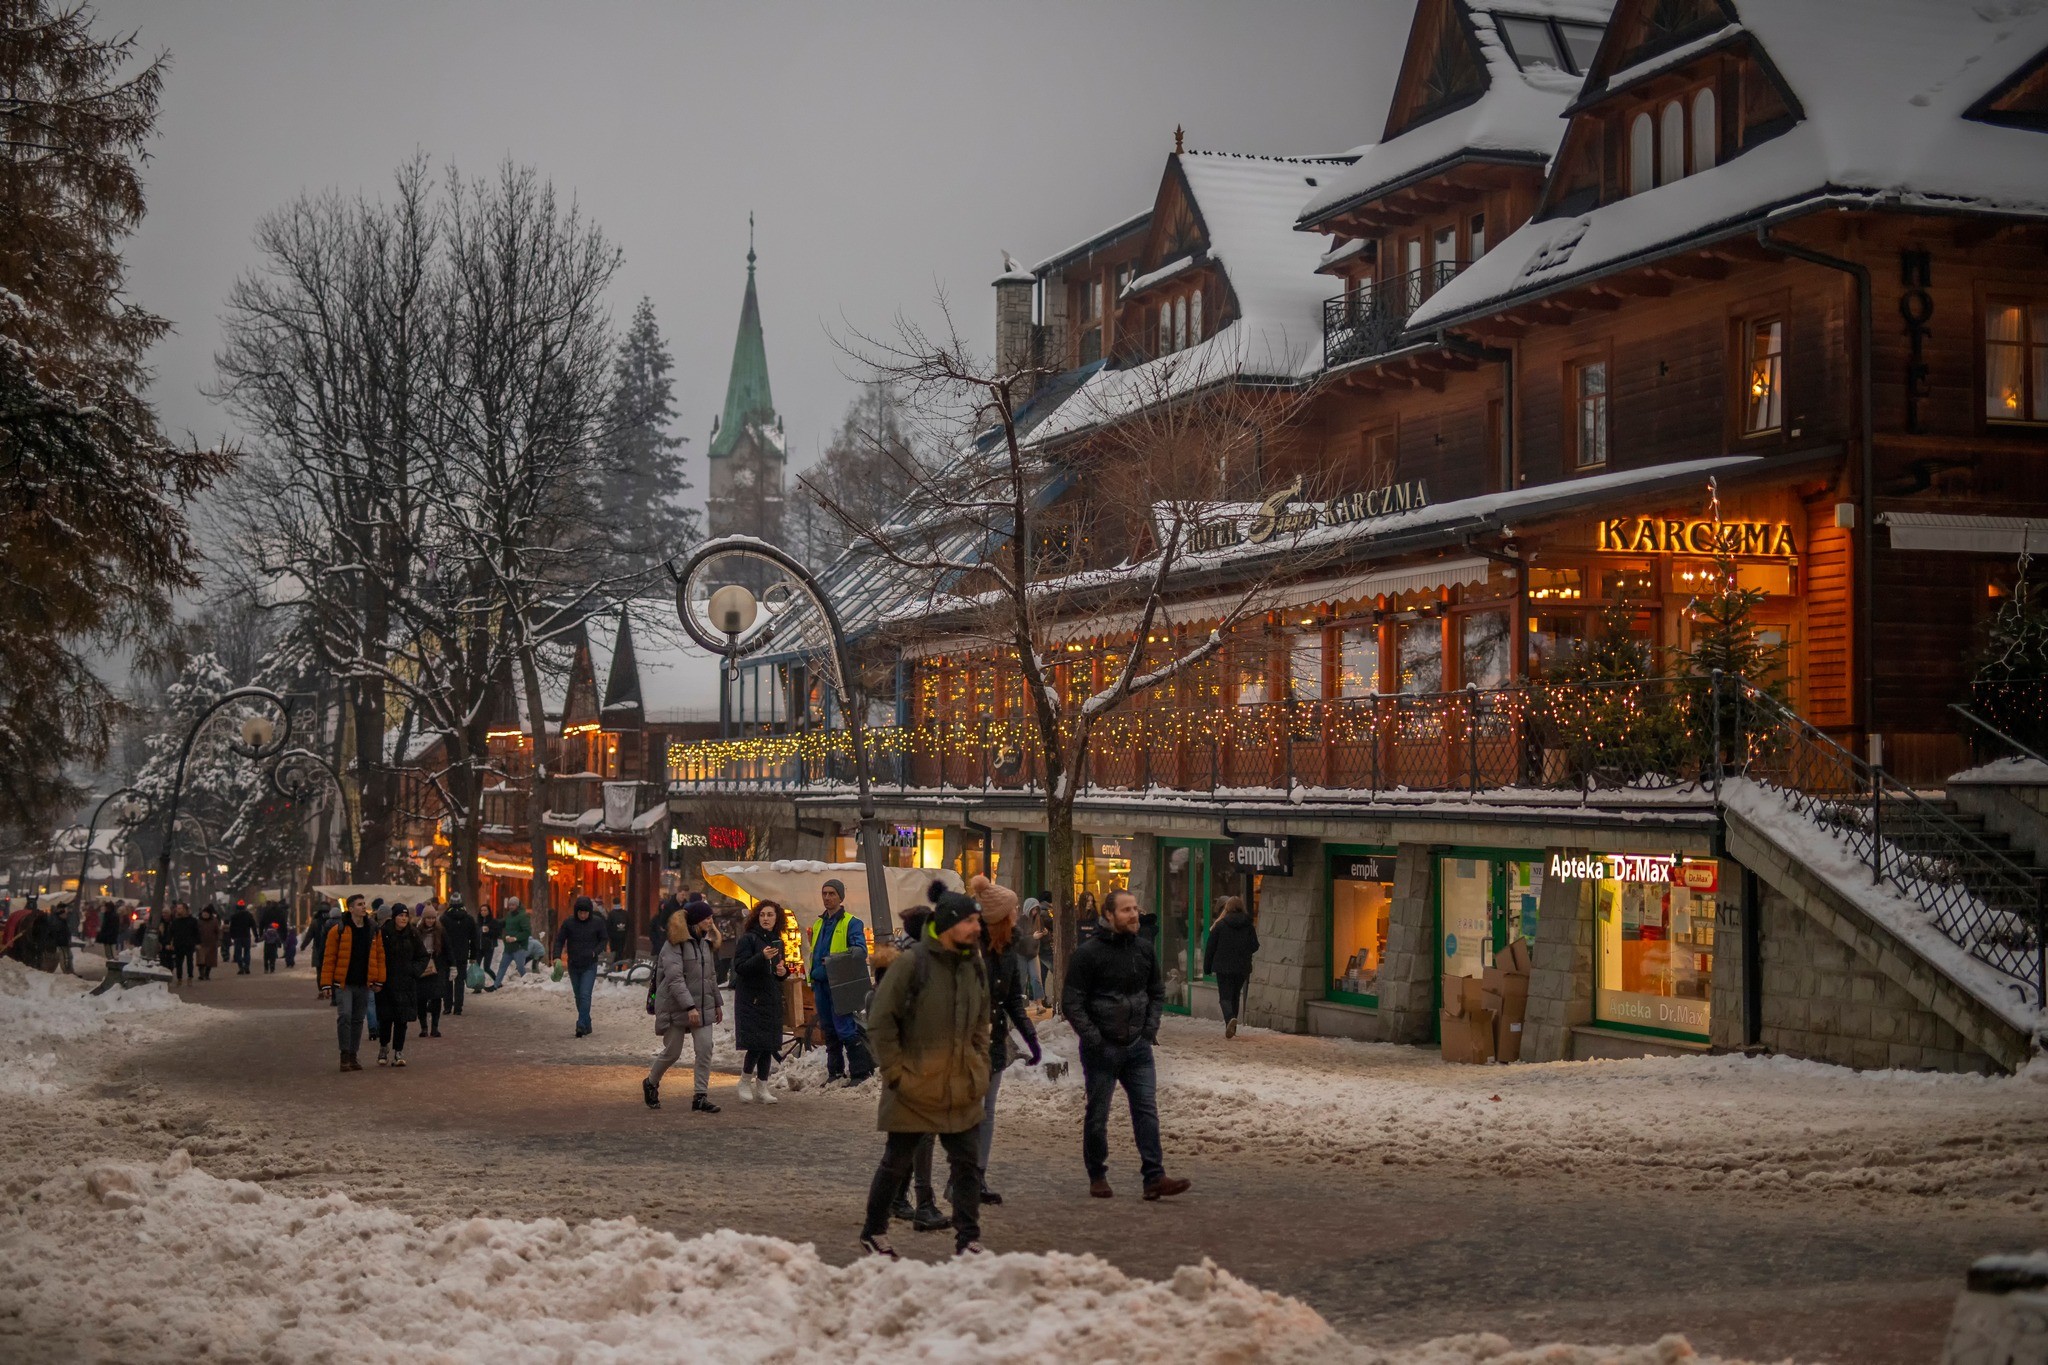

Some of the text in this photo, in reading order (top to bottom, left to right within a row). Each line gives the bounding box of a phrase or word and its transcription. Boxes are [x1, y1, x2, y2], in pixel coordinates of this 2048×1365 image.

[1324, 480, 1428, 525] KARCZMA
[1598, 516, 1798, 556] KARCZMA
[1101, 840, 1121, 857] empik
[1237, 838, 1278, 871] empik
[1351, 858, 1379, 880] empik
[1550, 854, 1604, 883] Apteka
[1609, 998, 1652, 1020] Apteka
